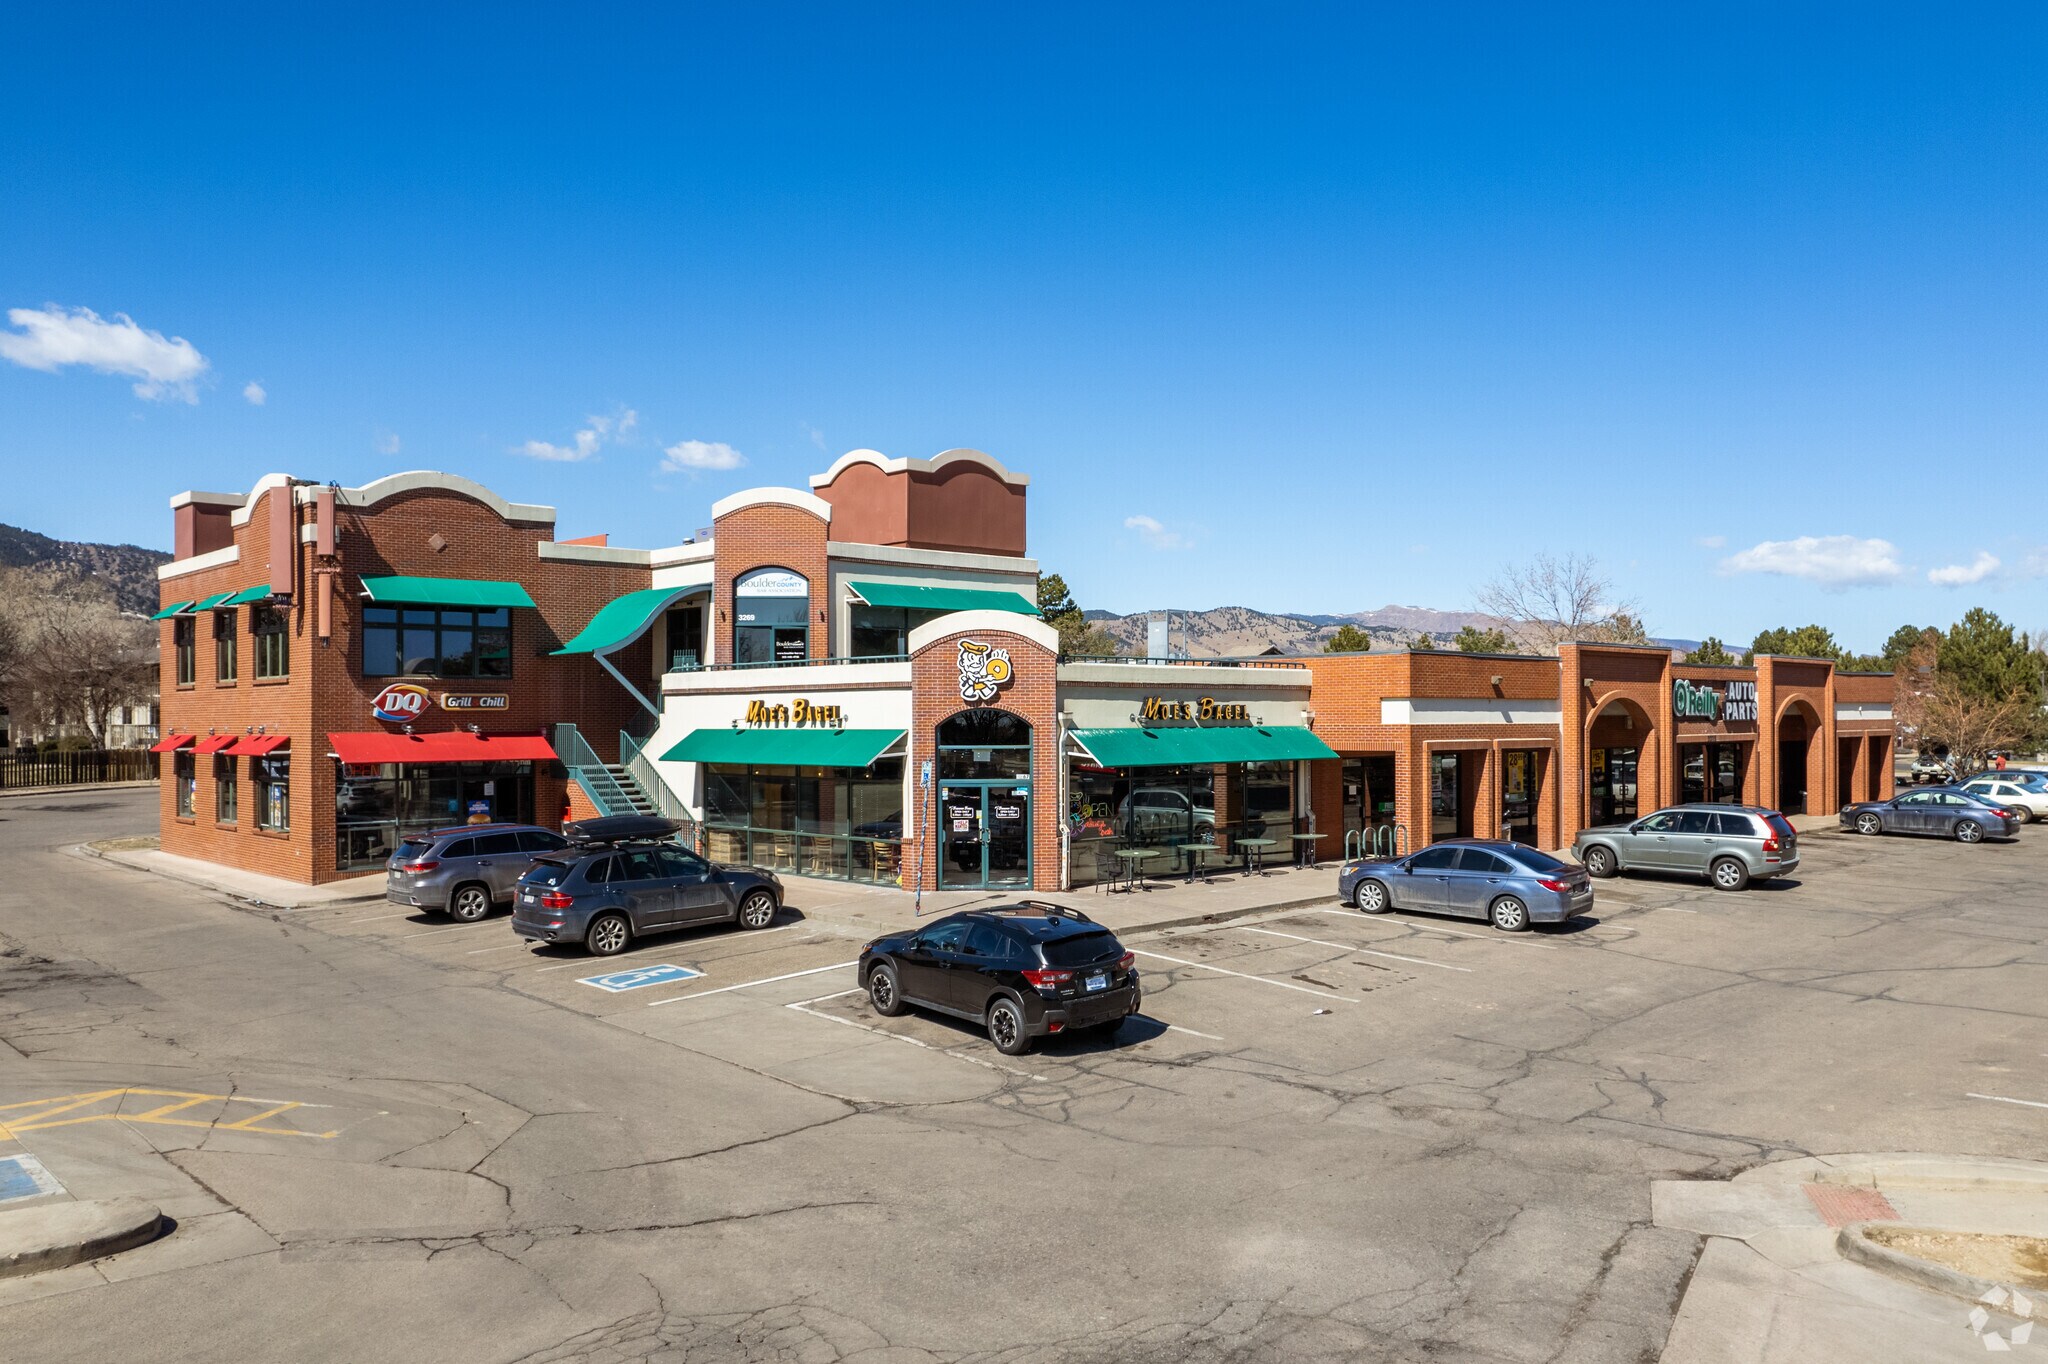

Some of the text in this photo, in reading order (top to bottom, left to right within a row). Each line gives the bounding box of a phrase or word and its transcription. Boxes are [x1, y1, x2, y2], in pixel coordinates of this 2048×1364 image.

[740, 577, 777, 588] Boulder
[1673, 679, 1721, 720] O'Reilly
[1727, 681, 1756, 701] AUTO
[383, 692, 422, 713] DQ
[447, 696, 472, 707] Grill
[479, 696, 505, 707] Chill
[1725, 701, 1758, 721] PARTS
